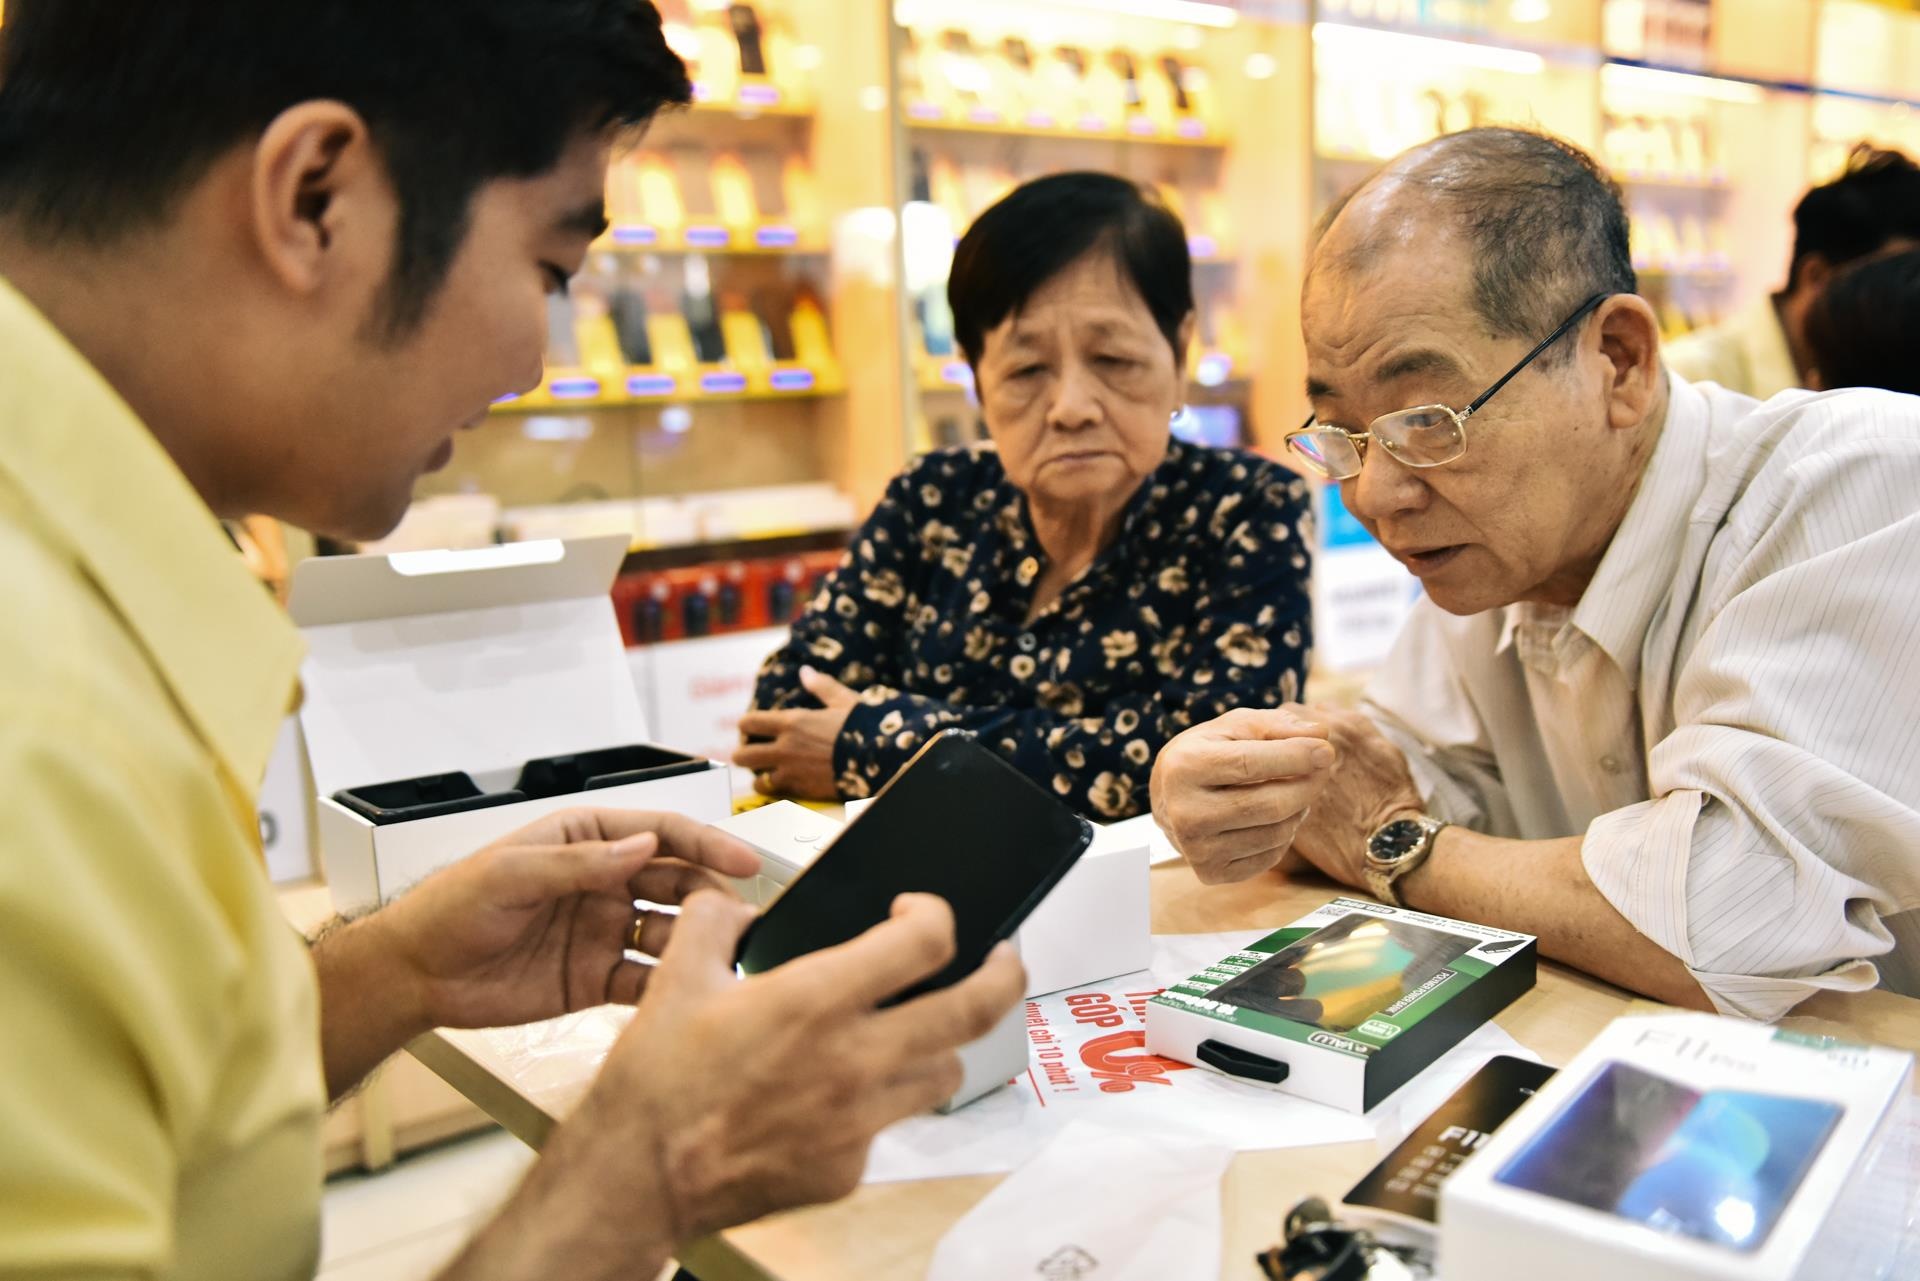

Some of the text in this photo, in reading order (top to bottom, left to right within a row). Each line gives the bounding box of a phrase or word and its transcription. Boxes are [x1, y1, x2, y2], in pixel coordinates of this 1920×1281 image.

[1065, 993, 1128, 1028] GÓP
[1036, 1046, 1064, 1059] 10
[1039, 1062, 1075, 1085] phút
